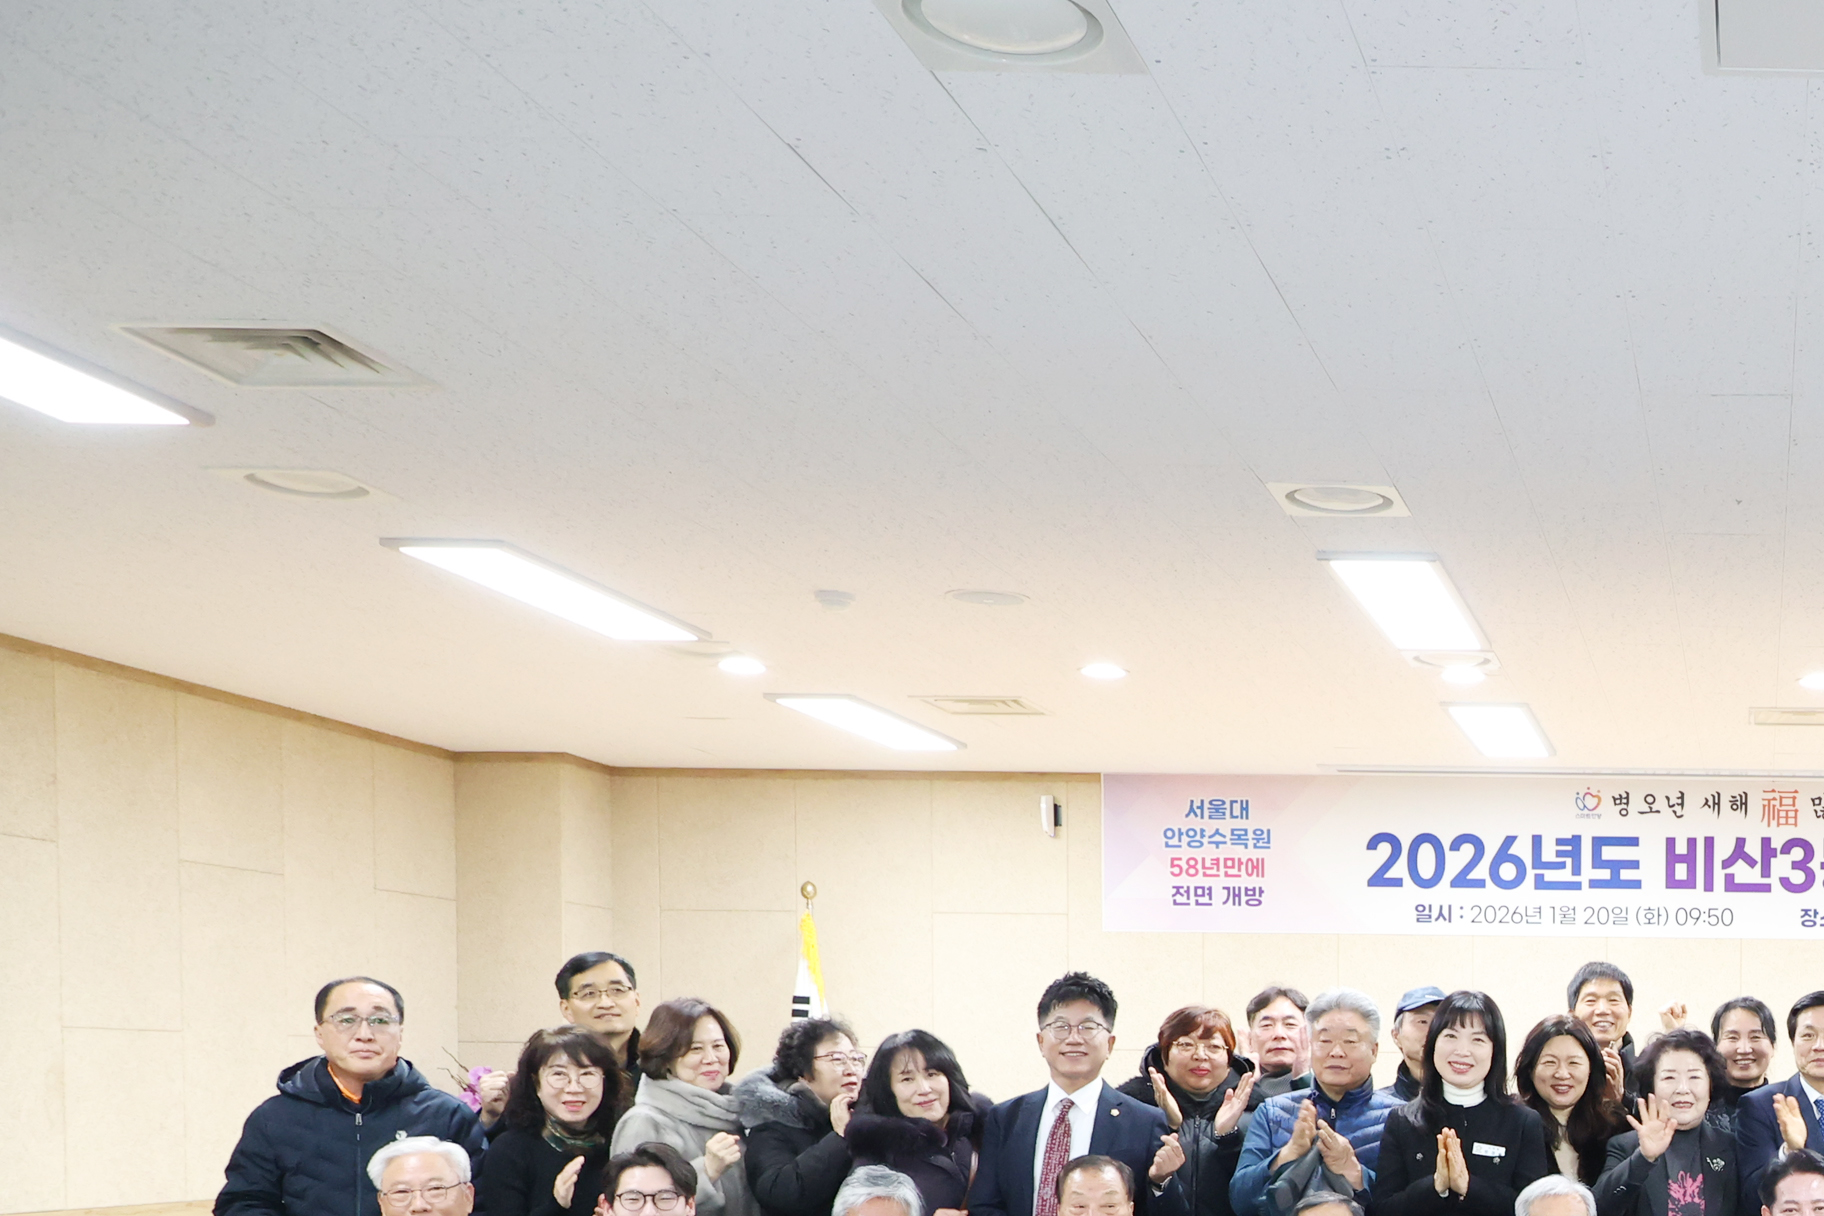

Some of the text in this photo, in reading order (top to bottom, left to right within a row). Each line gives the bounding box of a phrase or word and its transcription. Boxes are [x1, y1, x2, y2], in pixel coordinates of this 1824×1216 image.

[1185, 799, 1249, 820] 서울대
[1612, 791, 1684, 818] 병오년
[1761, 789, 1799, 827] 福
[1163, 828, 1270, 849] 안양수목원
[1170, 857, 1264, 878] 58년만에
[1366, 832, 1642, 890] 2026년도
[1172, 886, 1264, 907] 전면 개방
[1471, 905, 1541, 924] 2026년
[1550, 906, 1575, 924] 1월
[1584, 906, 1628, 925] 20일
[1636, 906, 1668, 926] (화)
[1675, 907, 1733, 926] 09:50
